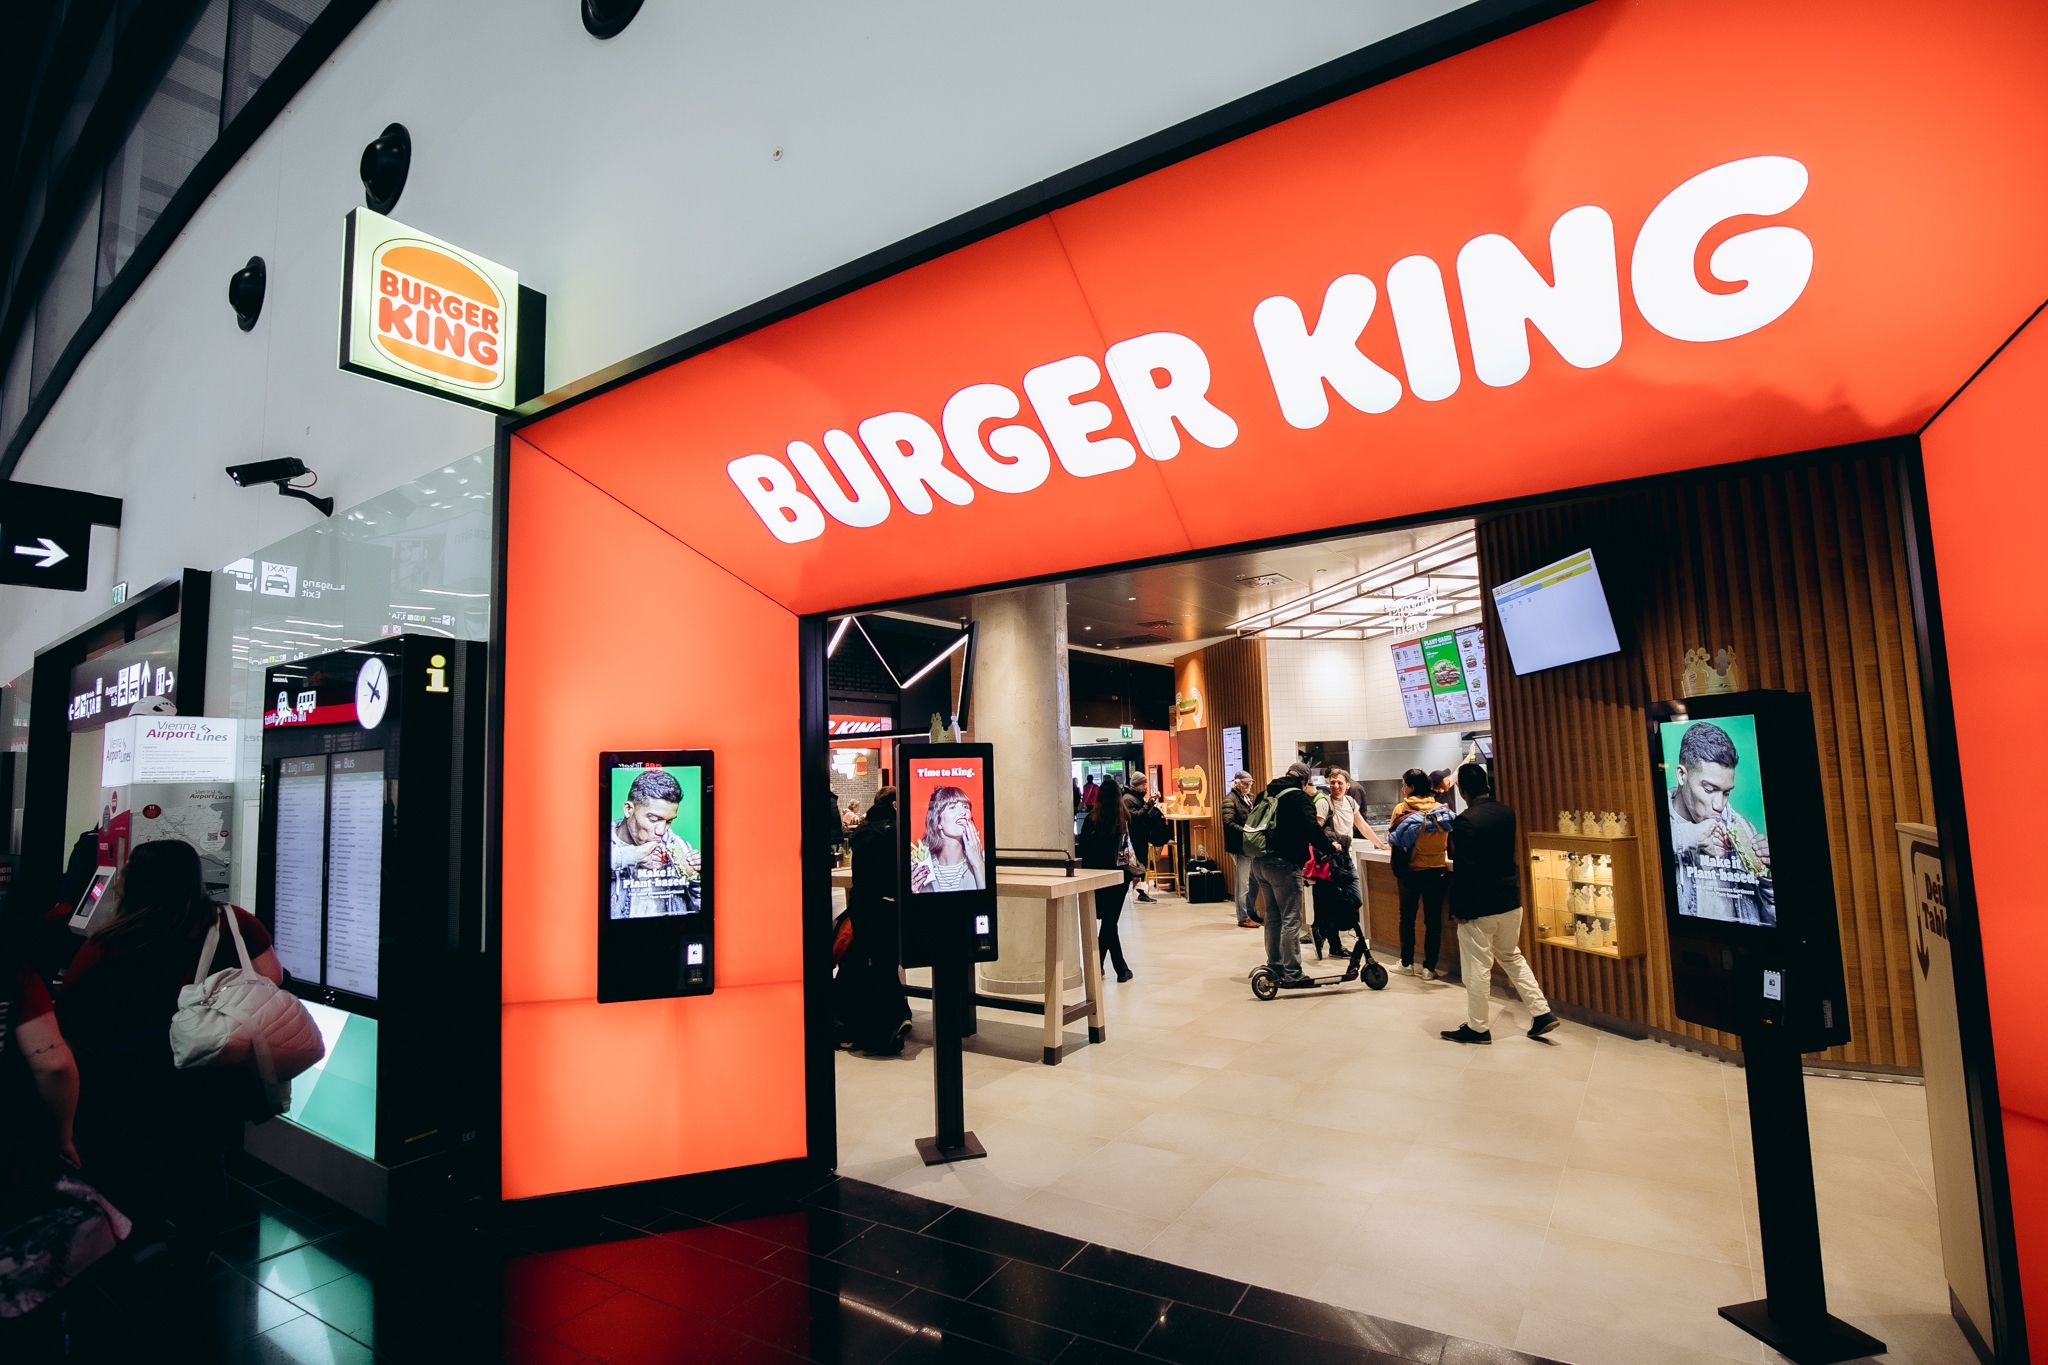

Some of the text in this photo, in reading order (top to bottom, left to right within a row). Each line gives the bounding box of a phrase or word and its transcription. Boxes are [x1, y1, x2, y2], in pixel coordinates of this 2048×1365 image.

[380, 269, 499, 334] BURGER
[378, 296, 498, 366] KING
[726, 155, 1814, 544] BURGER KING
[157, 721, 197, 731] Vienna
[146, 729, 228, 742] Airport Lines
[343, 757, 355, 769] Bus
[917, 767, 975, 778] Time to King.
[1699, 854, 1742, 869] Make it
[637, 866, 676, 878] Make it
[1686, 866, 1760, 886] Plant-based.
[622, 876, 690, 889] Plant-based.
